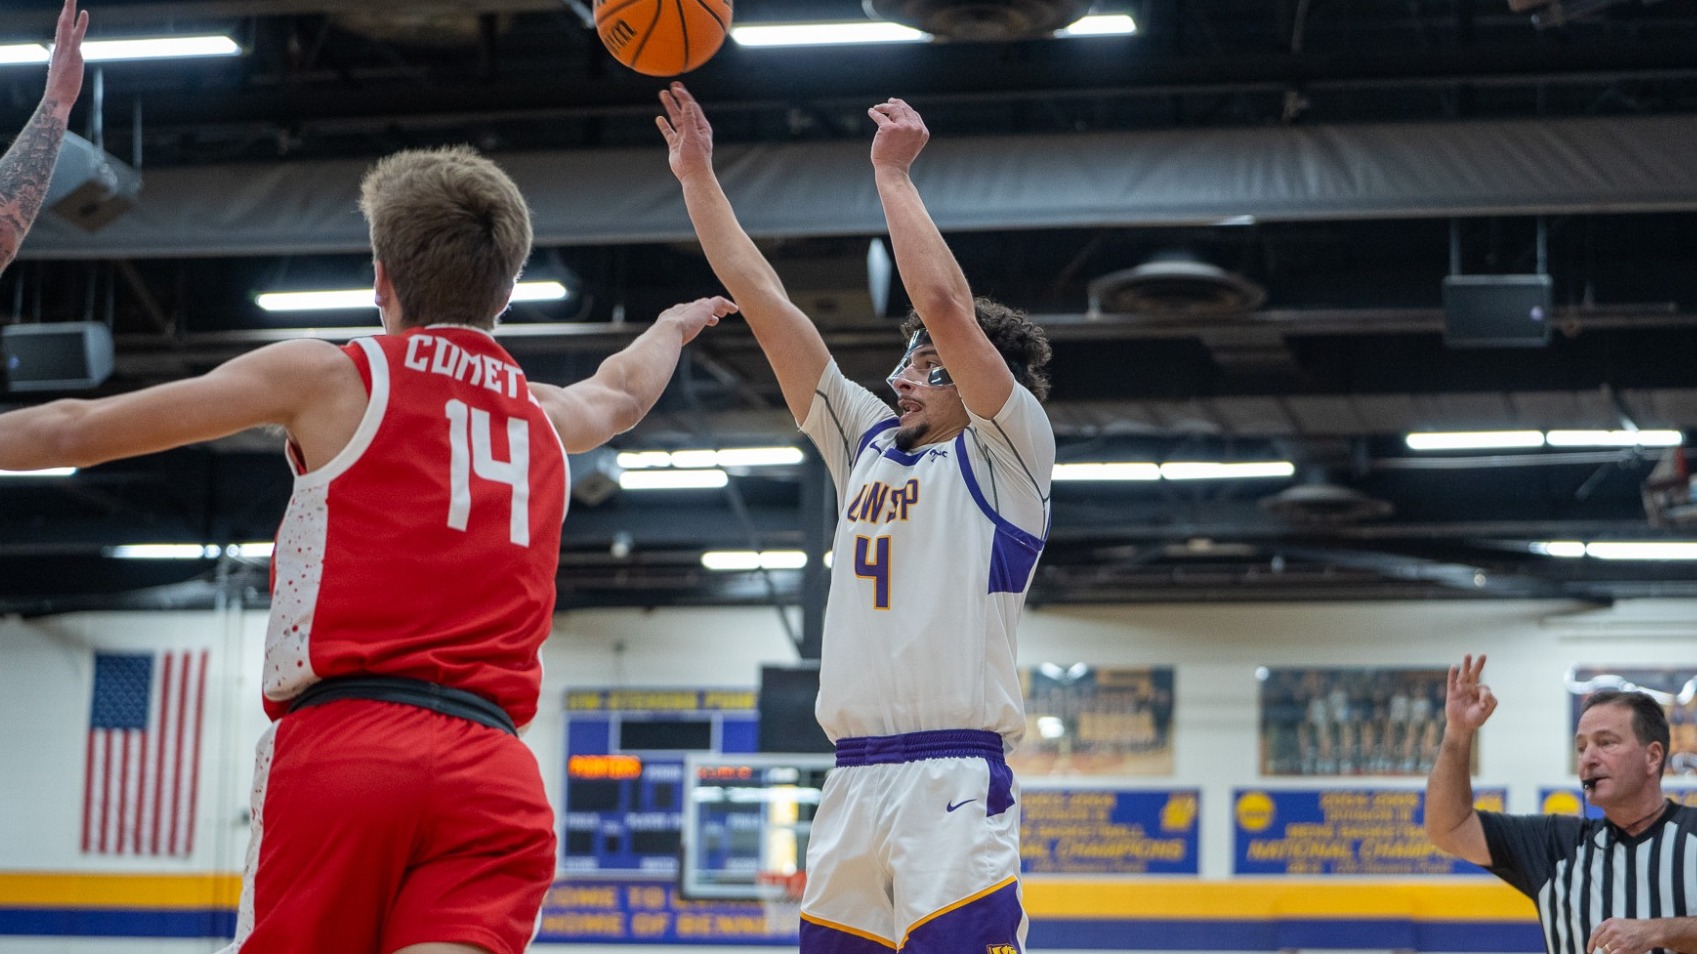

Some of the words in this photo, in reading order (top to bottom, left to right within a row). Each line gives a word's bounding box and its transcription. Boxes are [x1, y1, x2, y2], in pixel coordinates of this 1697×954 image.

[404, 334, 540, 407] COMET
[445, 398, 530, 548] 14
[854, 534, 891, 611] 4
